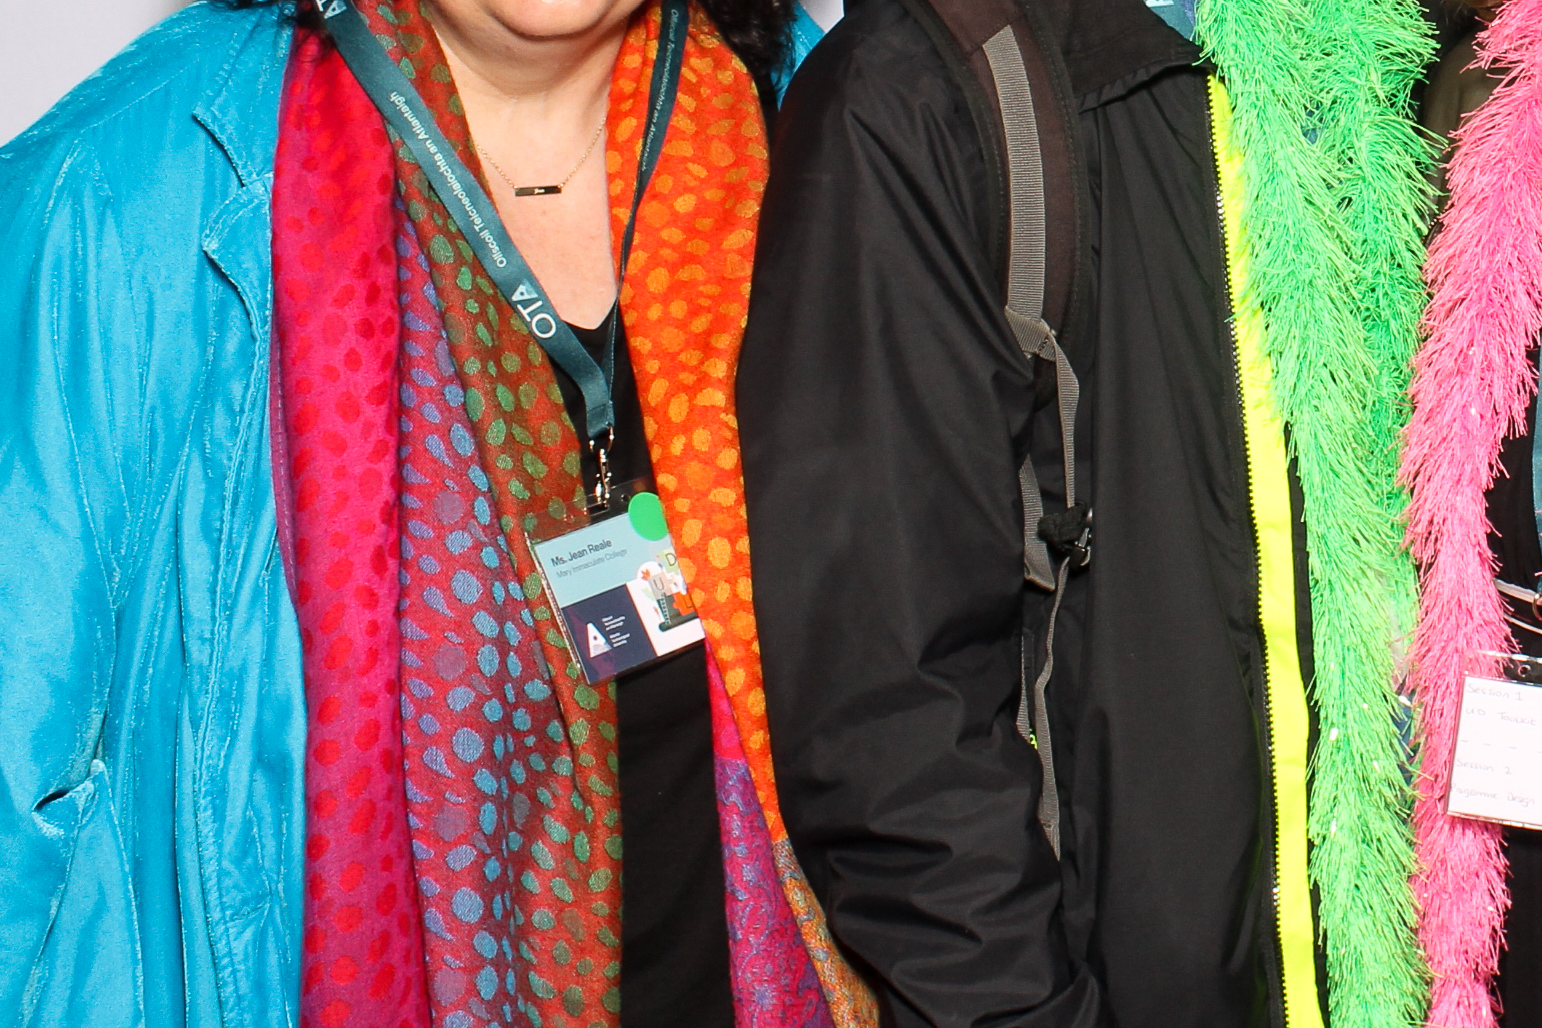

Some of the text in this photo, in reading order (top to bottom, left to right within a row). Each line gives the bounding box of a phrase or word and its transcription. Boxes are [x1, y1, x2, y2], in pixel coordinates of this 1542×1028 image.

[389, 91, 429, 140] Atlantaigh
[425, 139, 438, 154] an
[479, 229, 507, 268] Ollscoil
[511, 278, 557, 338] OTA
[551, 539, 612, 567] Ms. Jean Reale
[556, 568, 573, 578] Mary
[1467, 683, 1510, 699] Session
[1456, 758, 1512, 775] Session 2
